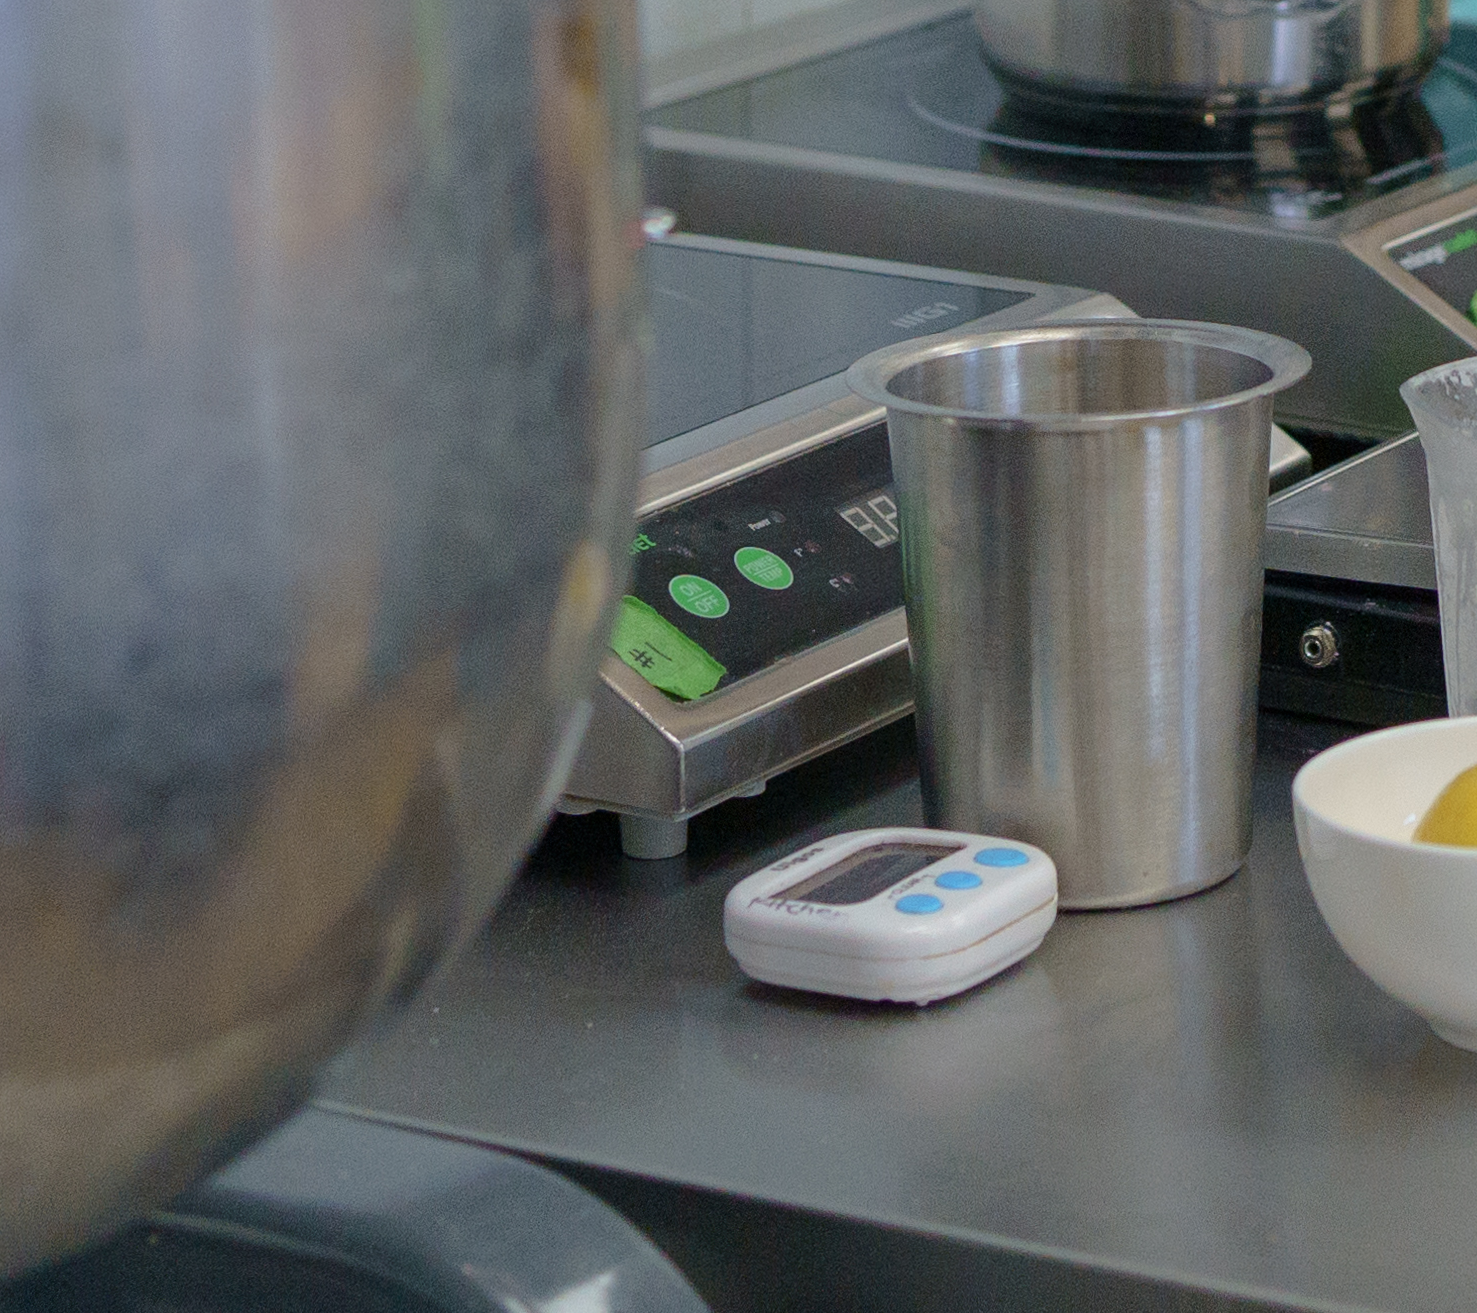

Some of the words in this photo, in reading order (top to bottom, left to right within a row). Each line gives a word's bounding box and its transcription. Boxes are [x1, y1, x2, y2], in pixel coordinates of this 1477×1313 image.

[742, 554, 779, 574] POWER
[679, 581, 702, 597] ON
[694, 594, 720, 614] OFF
